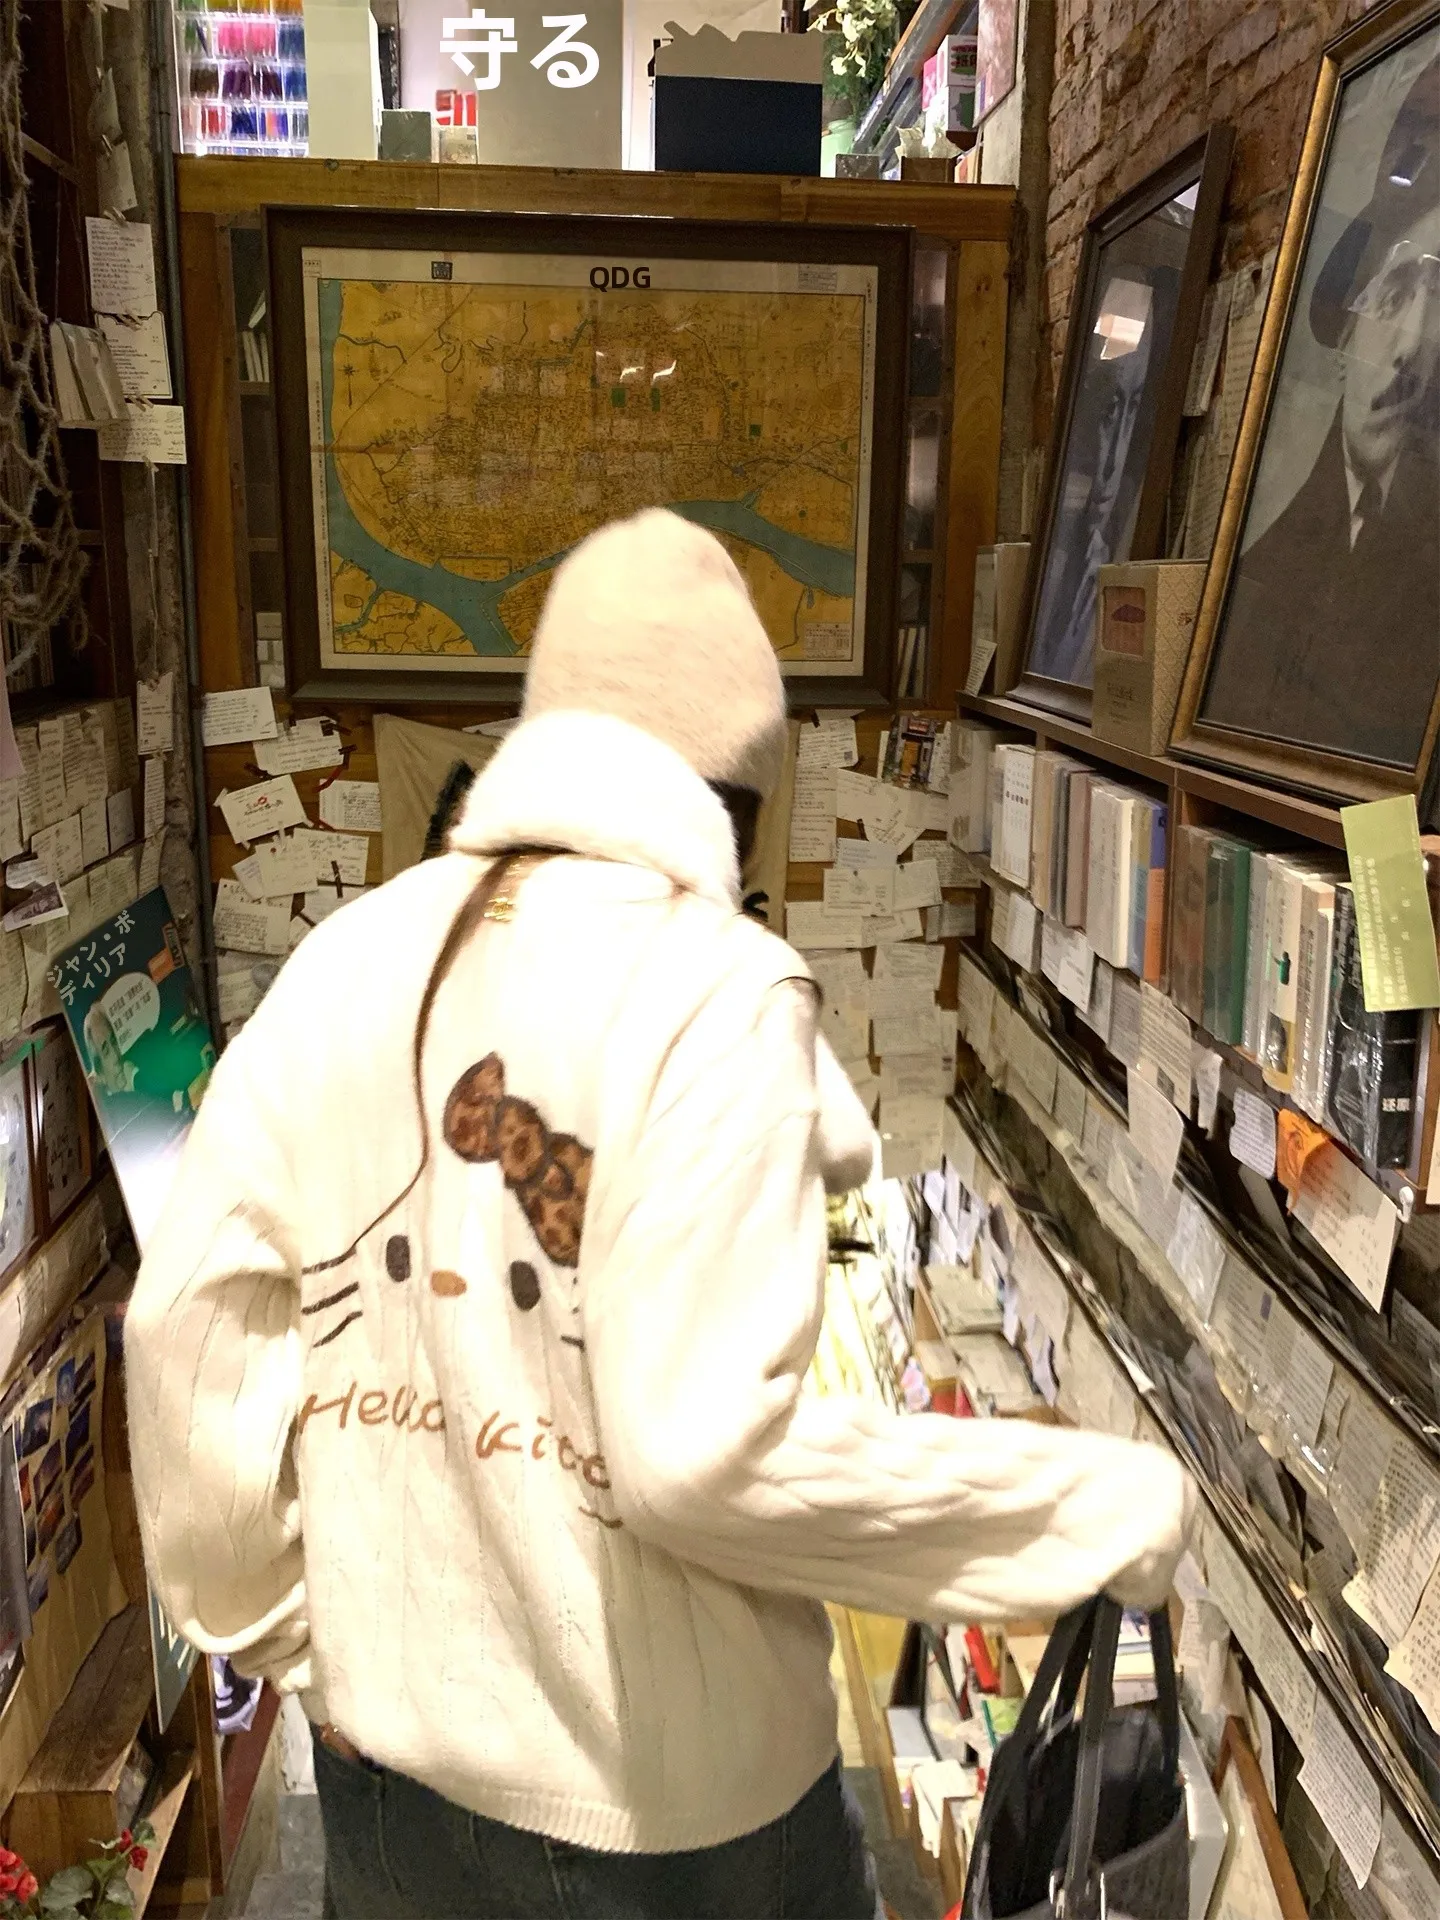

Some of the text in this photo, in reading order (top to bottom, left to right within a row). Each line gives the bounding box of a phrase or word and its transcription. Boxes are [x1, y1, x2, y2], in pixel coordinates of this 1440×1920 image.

[589, 266, 651, 293] QDG
[47, 909, 136, 989] ジャン・ボ
[59, 942, 127, 1006] ディリア
[299, 1380, 447, 1434] Hello
